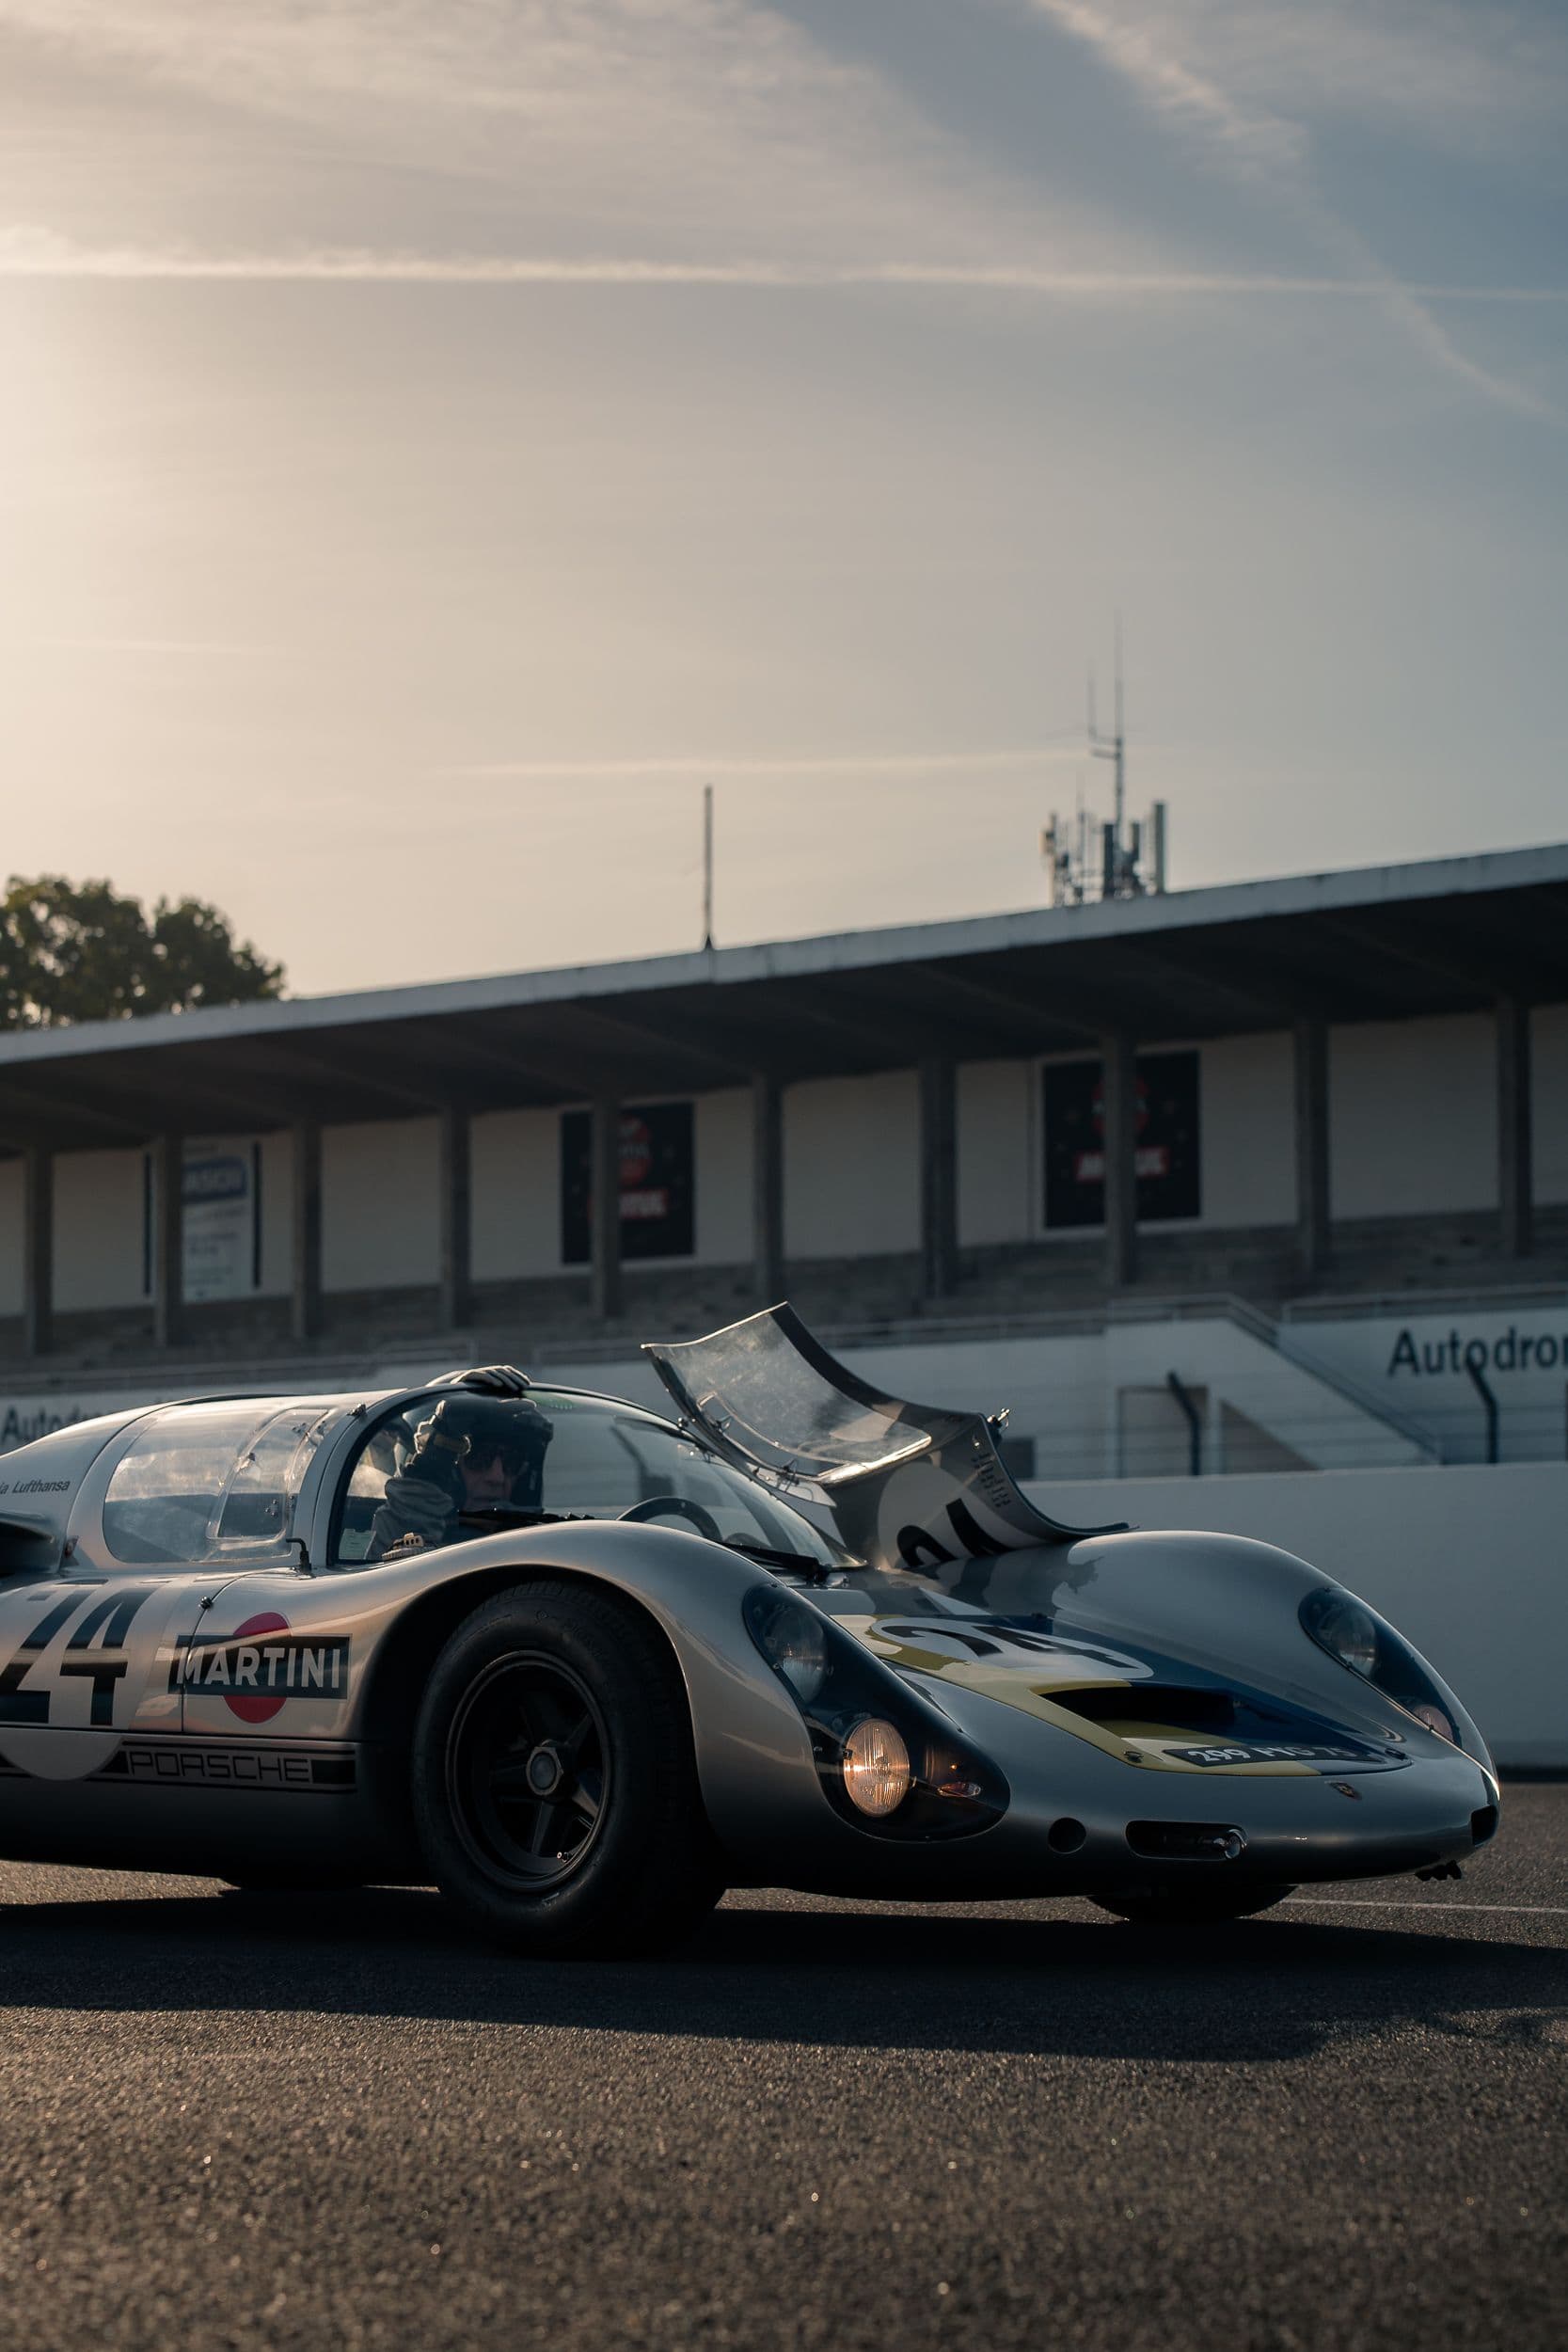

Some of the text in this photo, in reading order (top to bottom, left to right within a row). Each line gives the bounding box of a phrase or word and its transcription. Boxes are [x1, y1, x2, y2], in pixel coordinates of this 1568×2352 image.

[12, 1480, 71, 1493] Lufthansa
[177, 1647, 341, 1688] MARTINI
[1187, 1748, 1251, 1762] 299
[130, 1751, 309, 1782] PORSCHE
